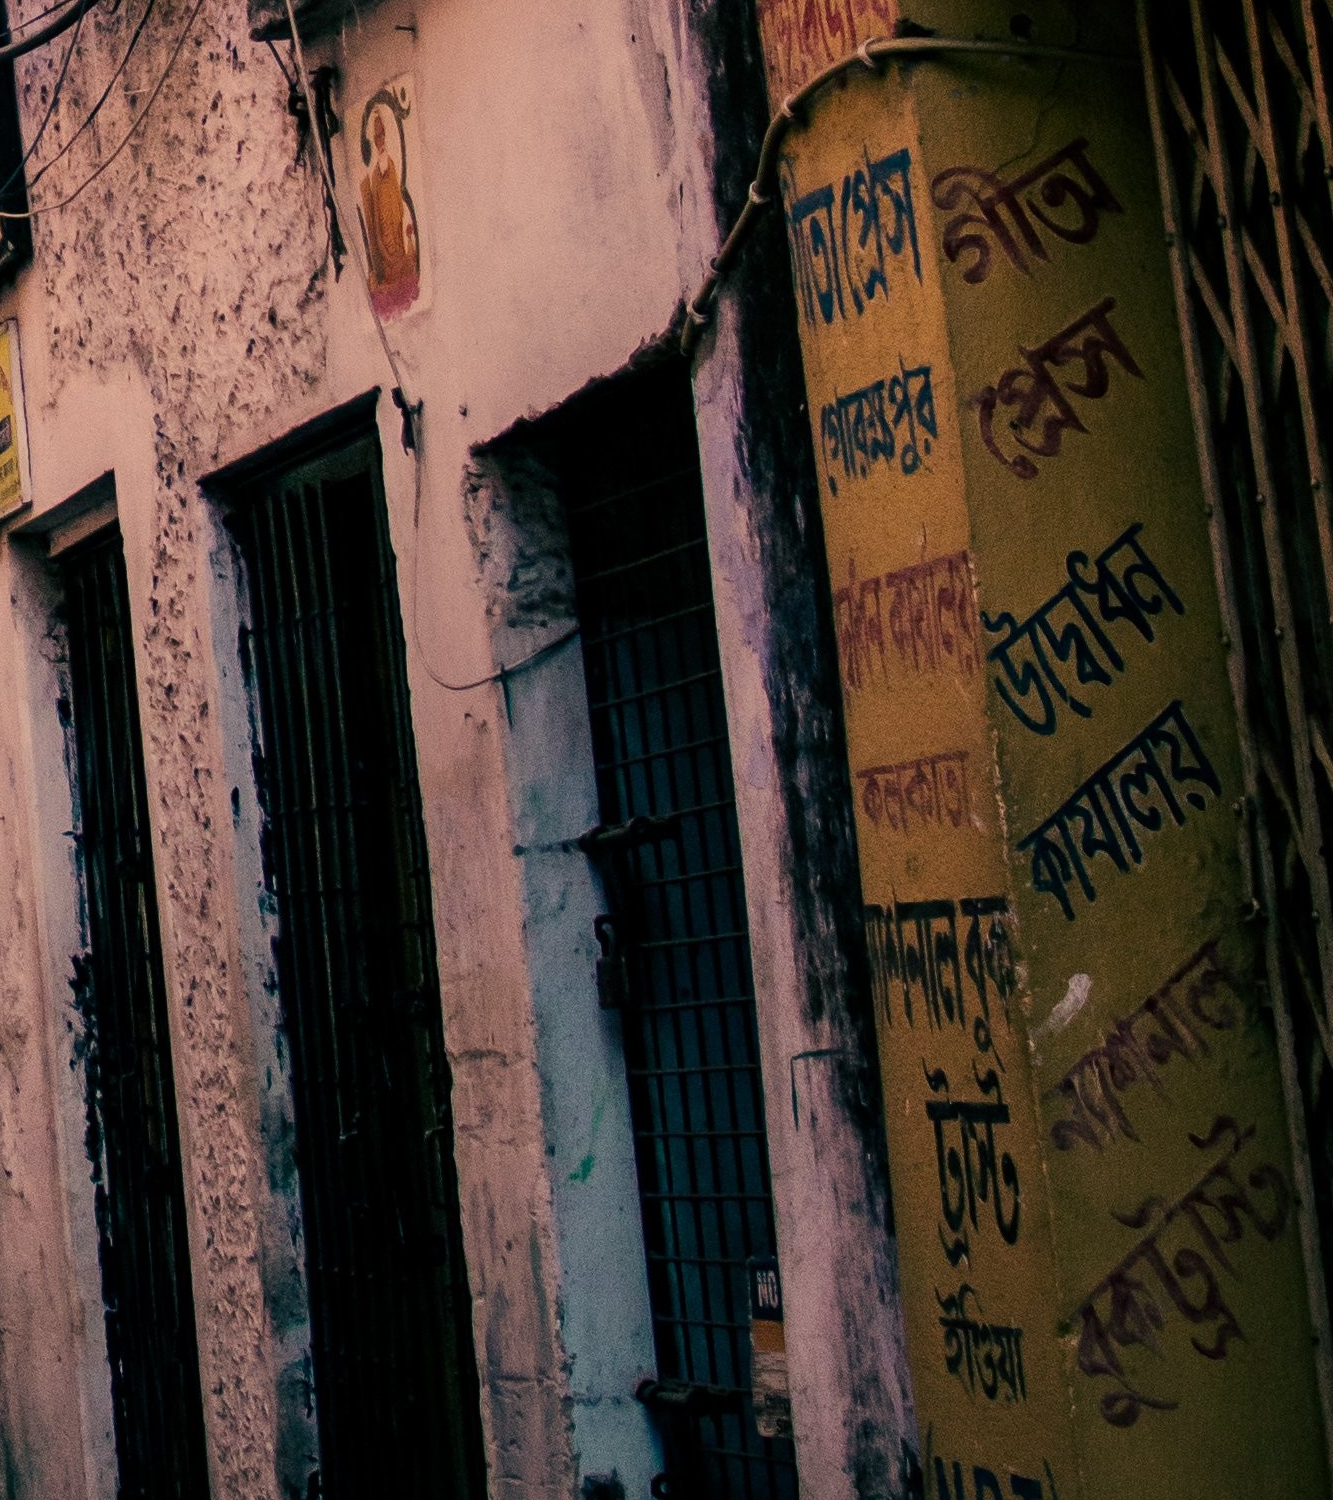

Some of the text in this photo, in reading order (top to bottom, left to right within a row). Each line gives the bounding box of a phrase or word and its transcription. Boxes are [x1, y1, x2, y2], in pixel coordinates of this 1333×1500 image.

[836, 142, 923, 316] প্রেস
[933, 138, 1124, 285] গীতা
[979, 296, 1148, 480] প্রেস
